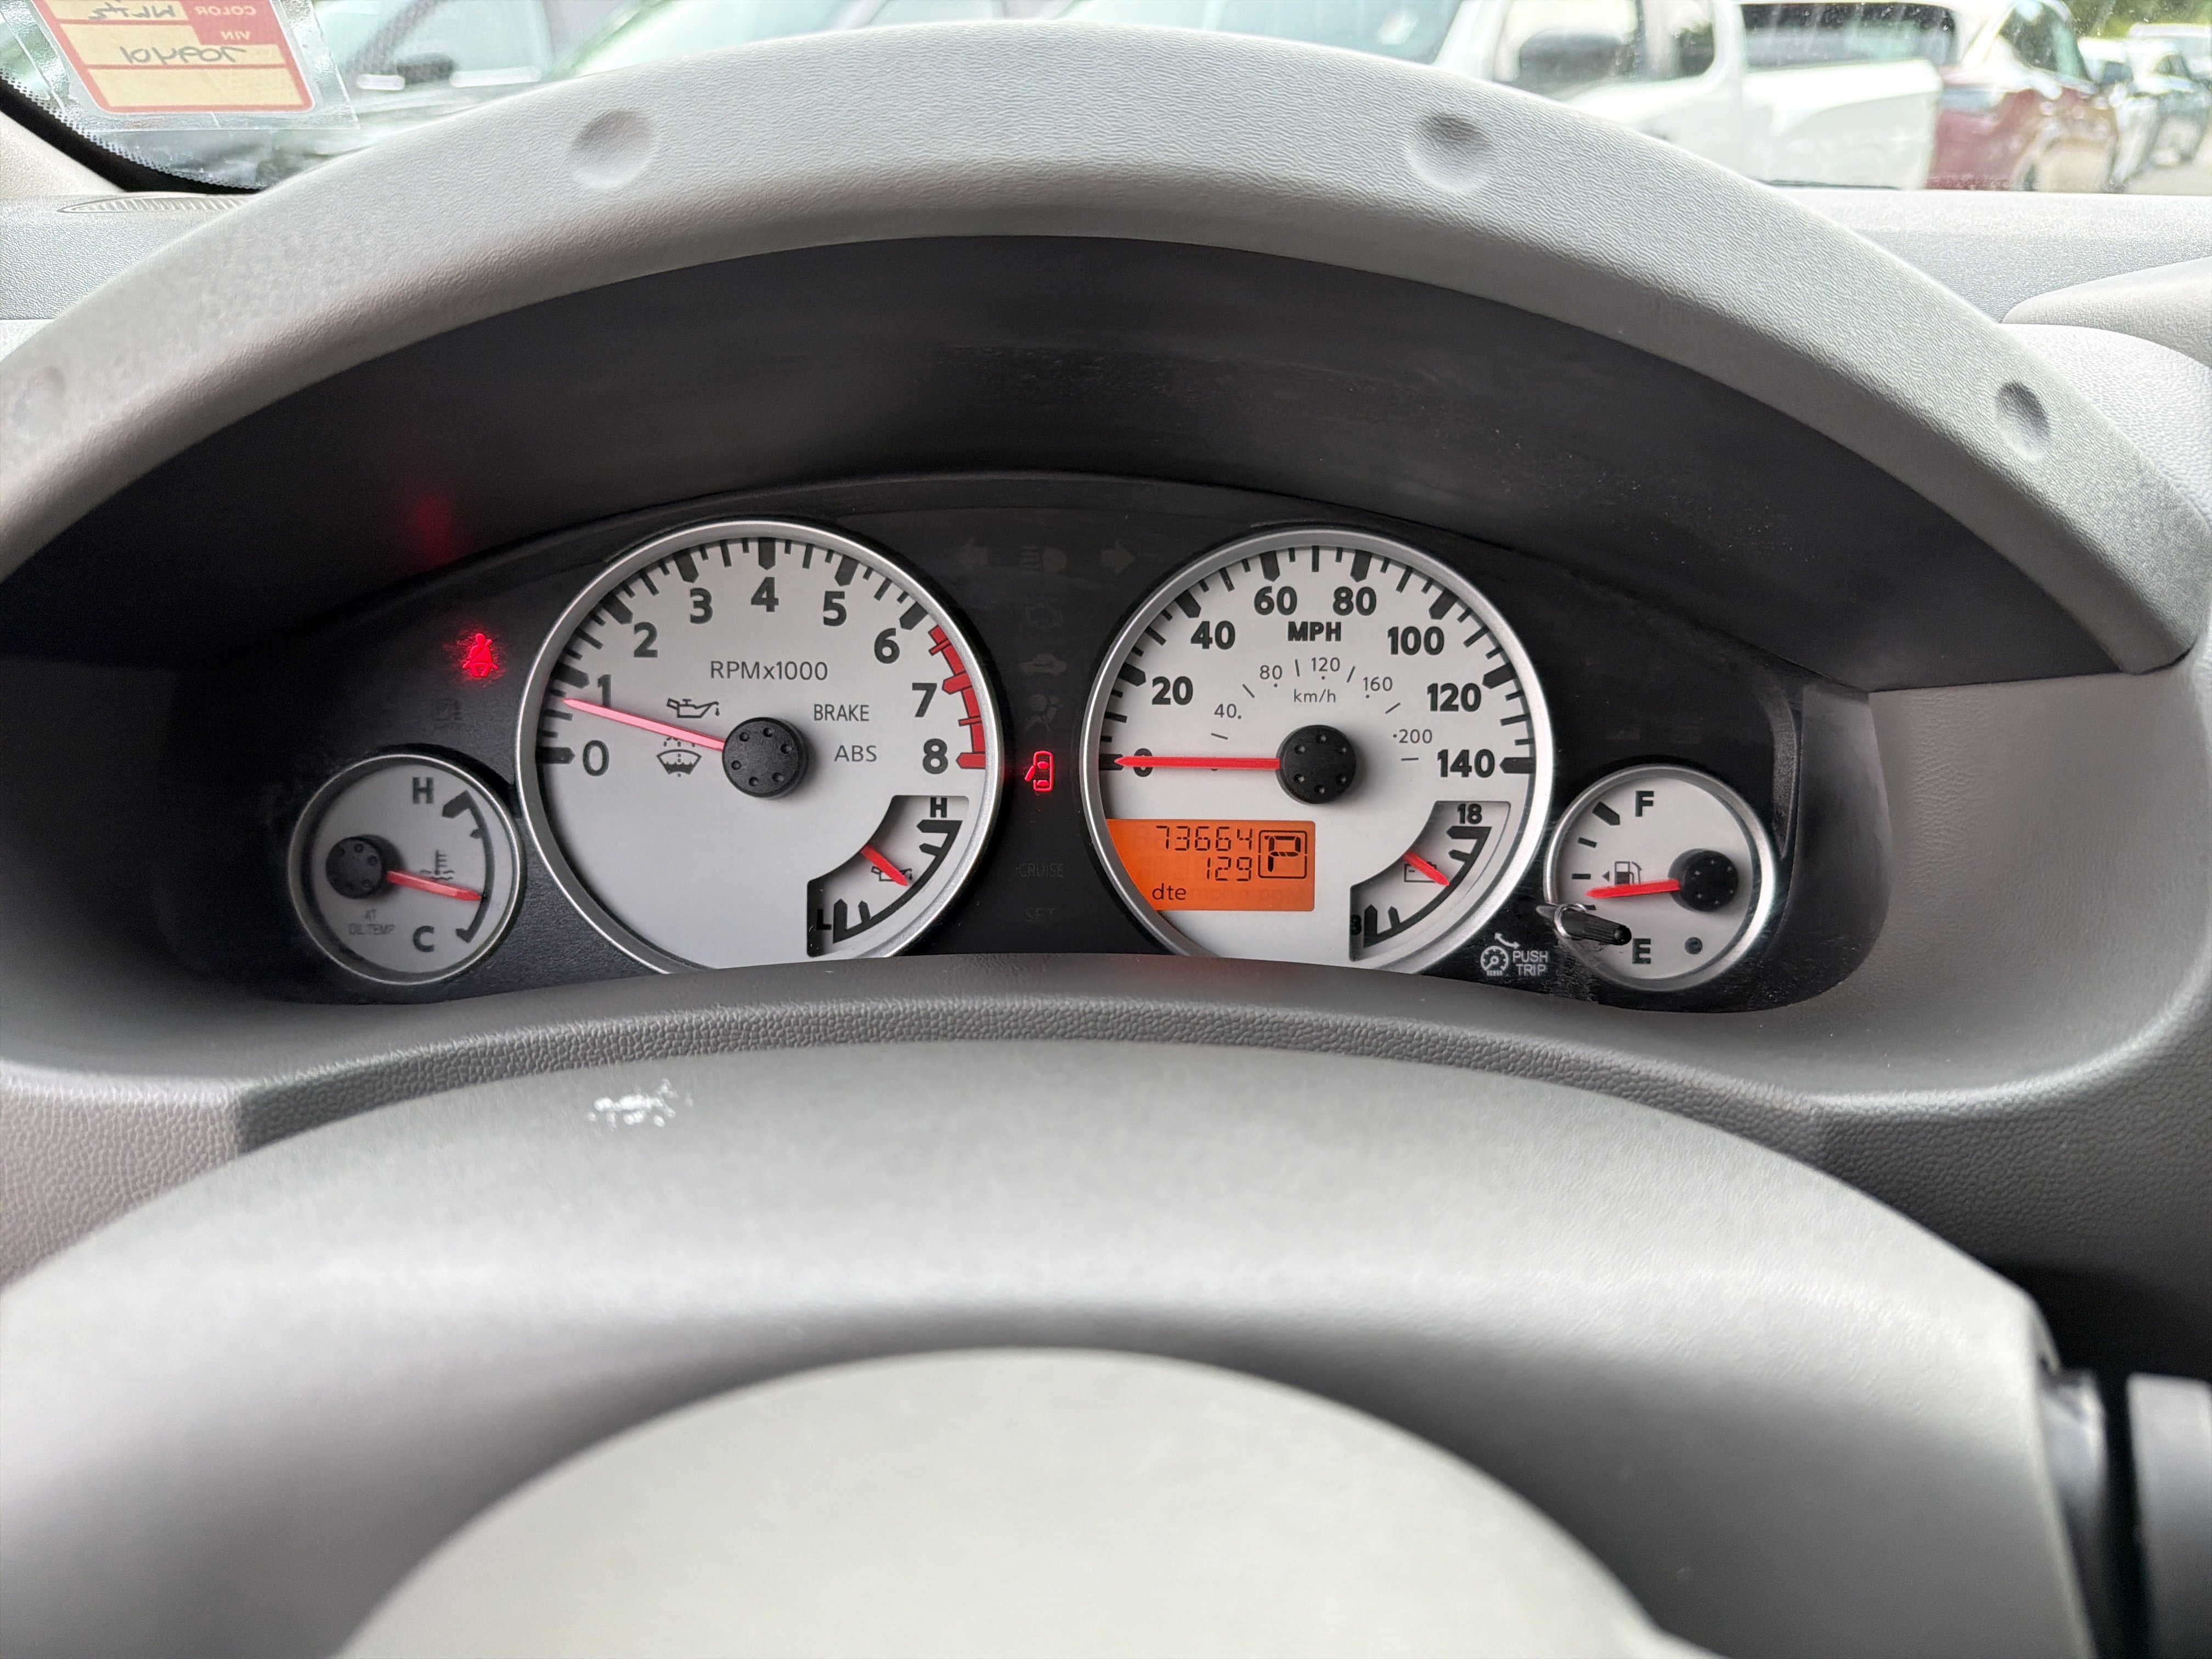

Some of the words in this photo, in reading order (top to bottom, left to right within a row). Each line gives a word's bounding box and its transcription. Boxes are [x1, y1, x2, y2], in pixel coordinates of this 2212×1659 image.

[690, 588, 713, 624] 3
[751, 577, 779, 612] 4
[1254, 586, 1297, 616] 60
[1332, 586, 1377, 616] 80
[823, 590, 847, 627] 5
[633, 622, 658, 658] 2
[1190, 620, 1236, 650] 40
[1288, 621, 1341, 641] MPH
[1387, 626, 1444, 656] 100
[874, 628, 900, 664] 6
[710, 661, 828, 680] RPMx1000
[1259, 664, 1283, 680] 80
[1311, 657, 1340, 672] 120
[597, 674, 611, 708] 1
[1152, 676, 1193, 706] 20
[1294, 689, 1336, 703] km/h
[1363, 676, 1393, 692] 160
[1427, 682, 1482, 712] 120
[814, 703, 870, 722] BRAKE
[912, 682, 938, 718] 7
[1214, 703, 1237, 719] 40
[1398, 729, 1432, 743] 200
[583, 739, 610, 777] 0
[834, 744, 878, 763] ABS
[922, 738, 949, 774] 8
[1436, 749, 1496, 778] 140
[411, 777, 435, 804] H
[930, 797, 947, 818] H
[1457, 803, 1482, 824] 18
[1635, 791, 1655, 817] F
[1155, 826, 1253, 851] 73664
[1264, 836, 1301, 872] P
[1019, 863, 1065, 878] CRUISE
[1206, 857, 1253, 882] 129
[1152, 883, 1187, 901] dte
[366, 923, 395, 935] TEMP
[412, 925, 435, 952] C
[1513, 950, 1548, 963] PUSH
[1632, 938, 1651, 964] E
[1515, 963, 1546, 976] TRIP
